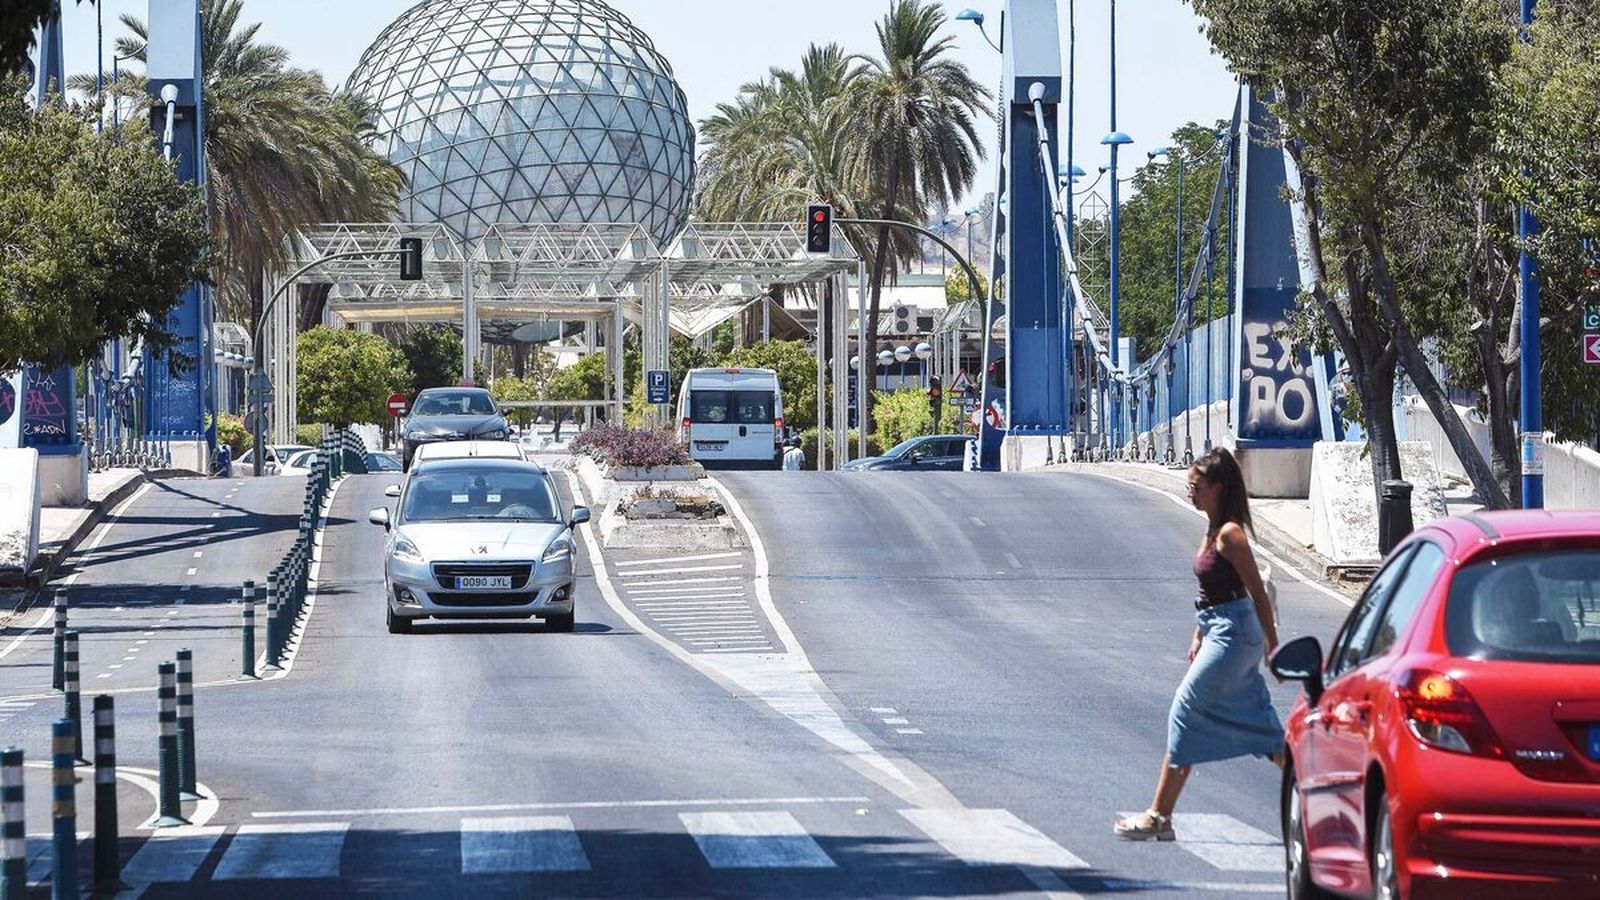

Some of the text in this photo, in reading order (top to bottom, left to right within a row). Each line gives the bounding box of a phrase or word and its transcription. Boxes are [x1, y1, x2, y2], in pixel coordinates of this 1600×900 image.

[655, 374, 663, 386] P
[463, 577, 507, 587] 0090 JYL
